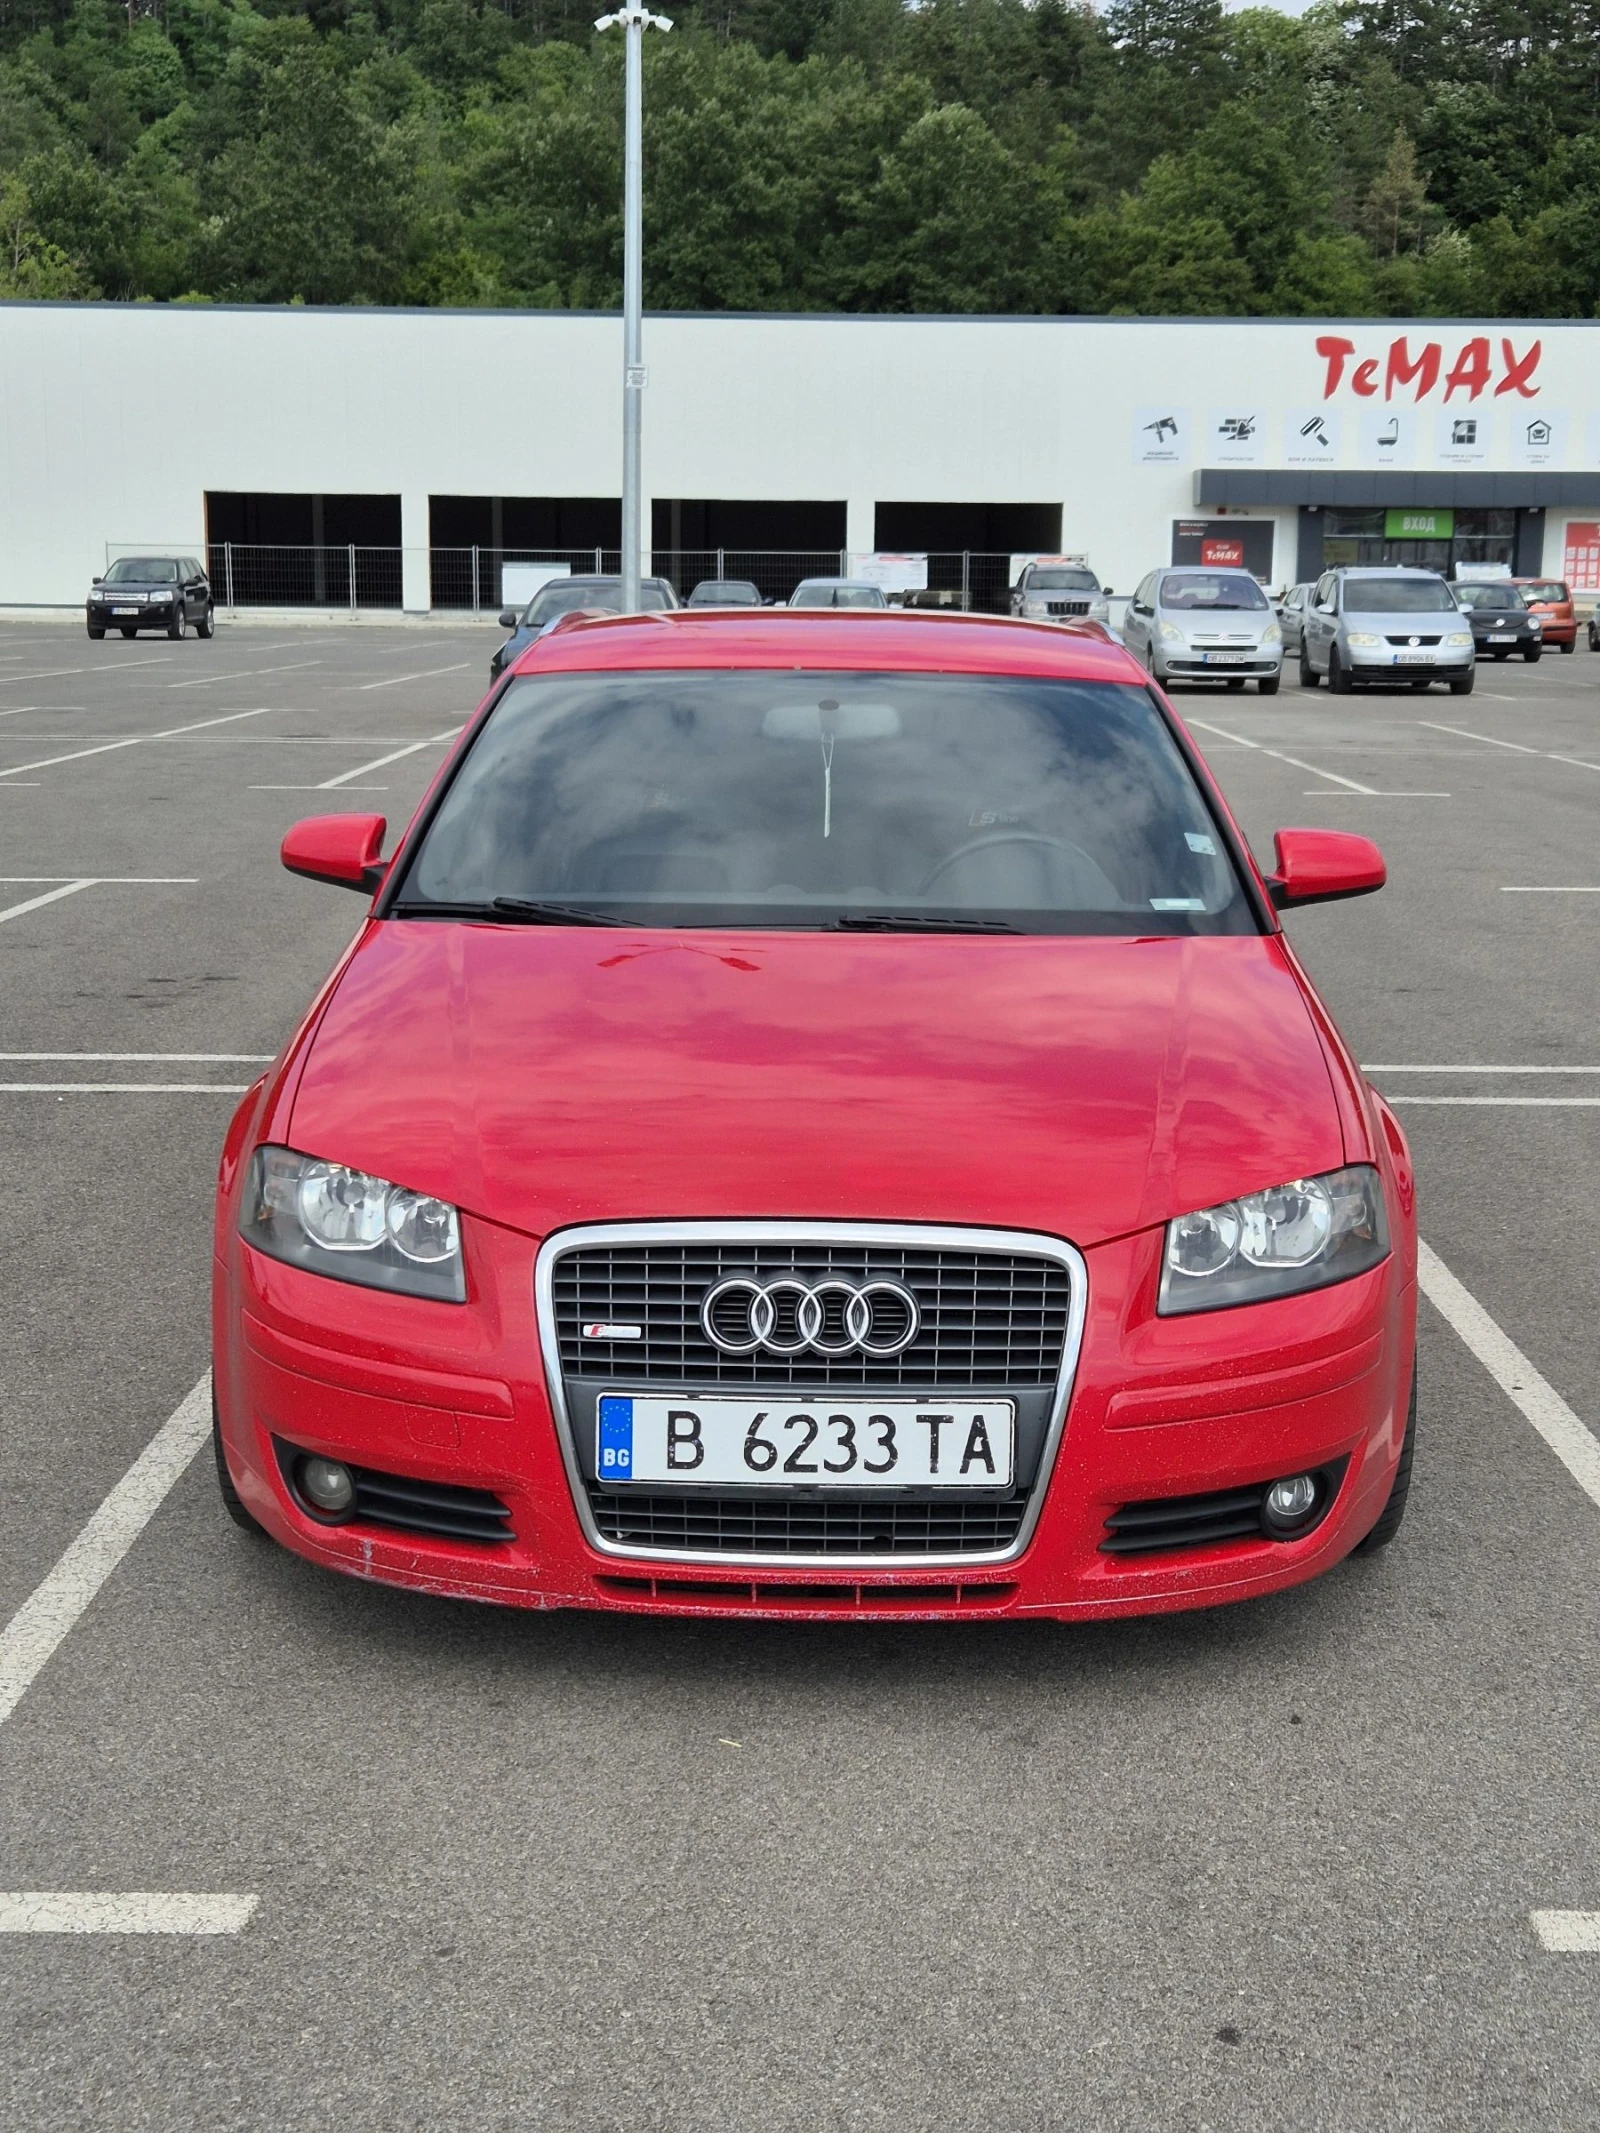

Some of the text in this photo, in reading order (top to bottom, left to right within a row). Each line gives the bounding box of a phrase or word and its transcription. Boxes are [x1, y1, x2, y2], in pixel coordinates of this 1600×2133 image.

[1315, 336, 1542, 403] TeMAX
[1402, 516, 1436, 533] ВХОД
[603, 1447, 630, 1468] BG
[667, 1410, 996, 1474] B 6233 TA
